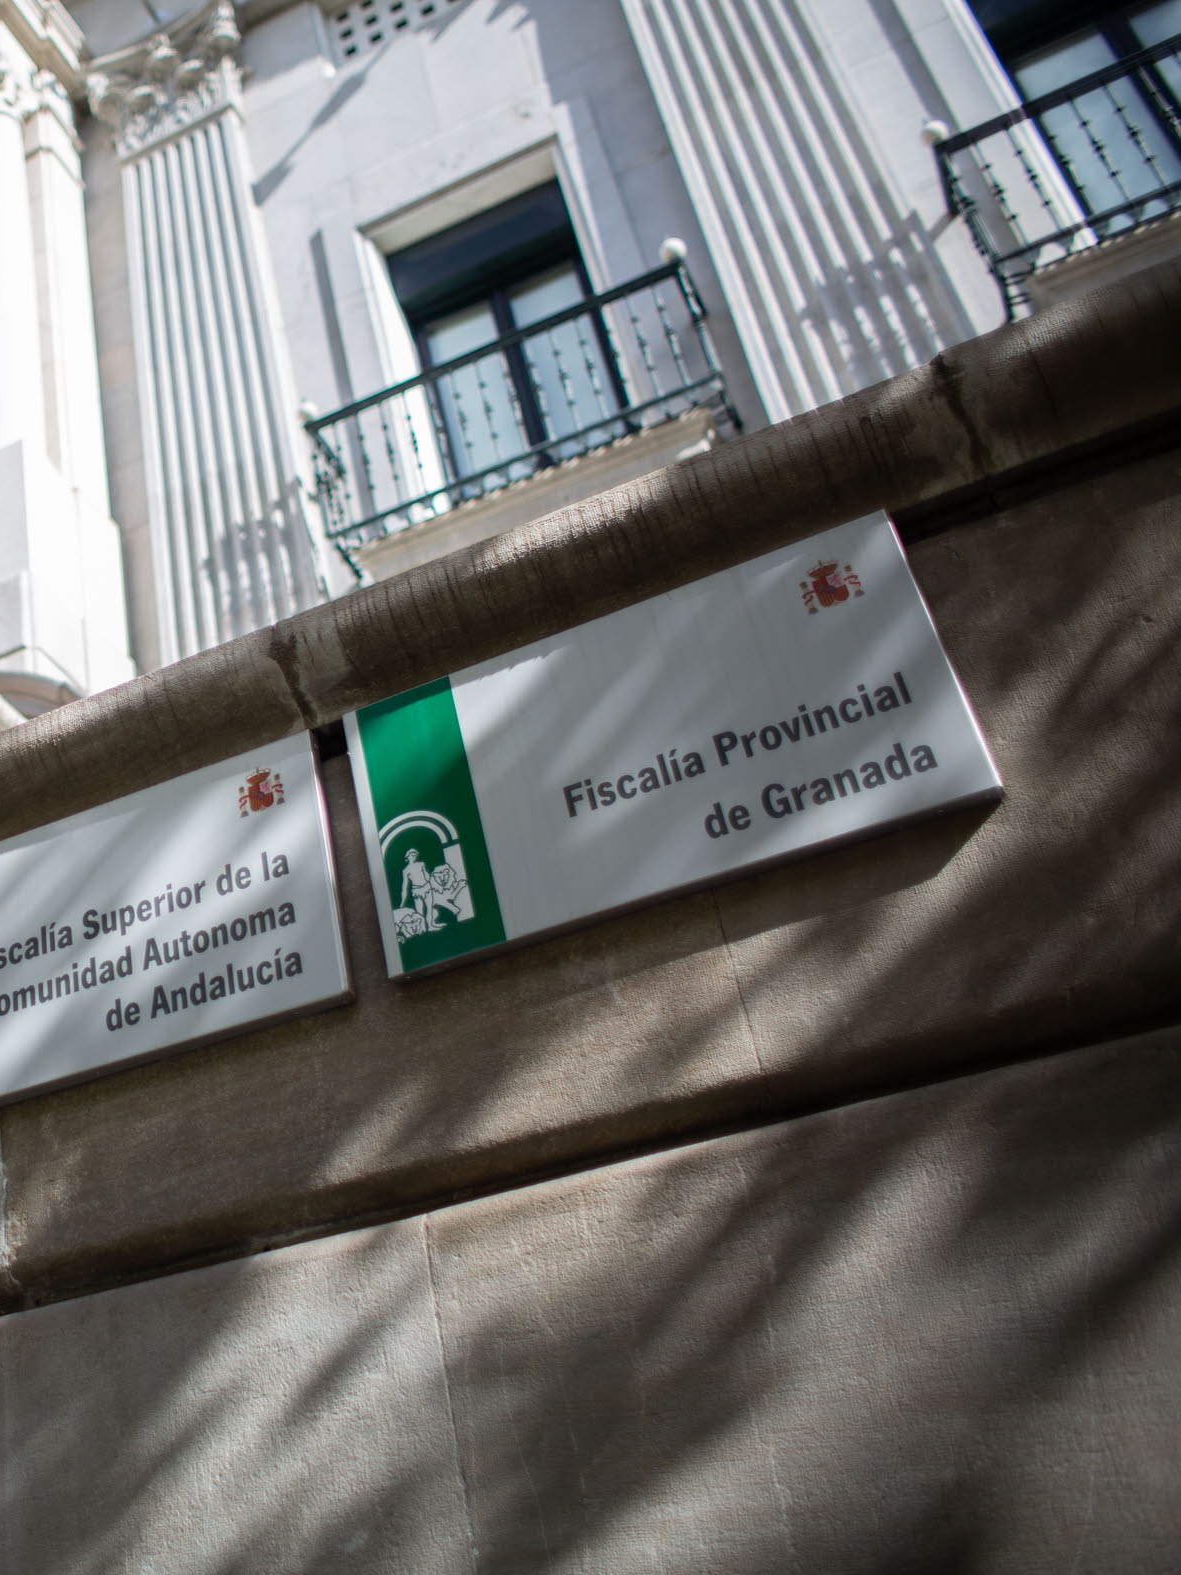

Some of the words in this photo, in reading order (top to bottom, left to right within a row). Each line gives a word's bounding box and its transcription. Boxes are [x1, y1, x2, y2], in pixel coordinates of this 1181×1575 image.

[563, 749, 706, 819] Fiscalía
[712, 671, 913, 767] Provincial
[704, 801, 752, 839] de
[761, 742, 939, 820] Granada
[82, 879, 207, 941] Superior
[215, 863, 252, 896] de
[261, 851, 291, 882] la
[142, 901, 297, 971] Autonoma
[105, 998, 141, 1032] de
[150, 947, 304, 1020] Andalucía
